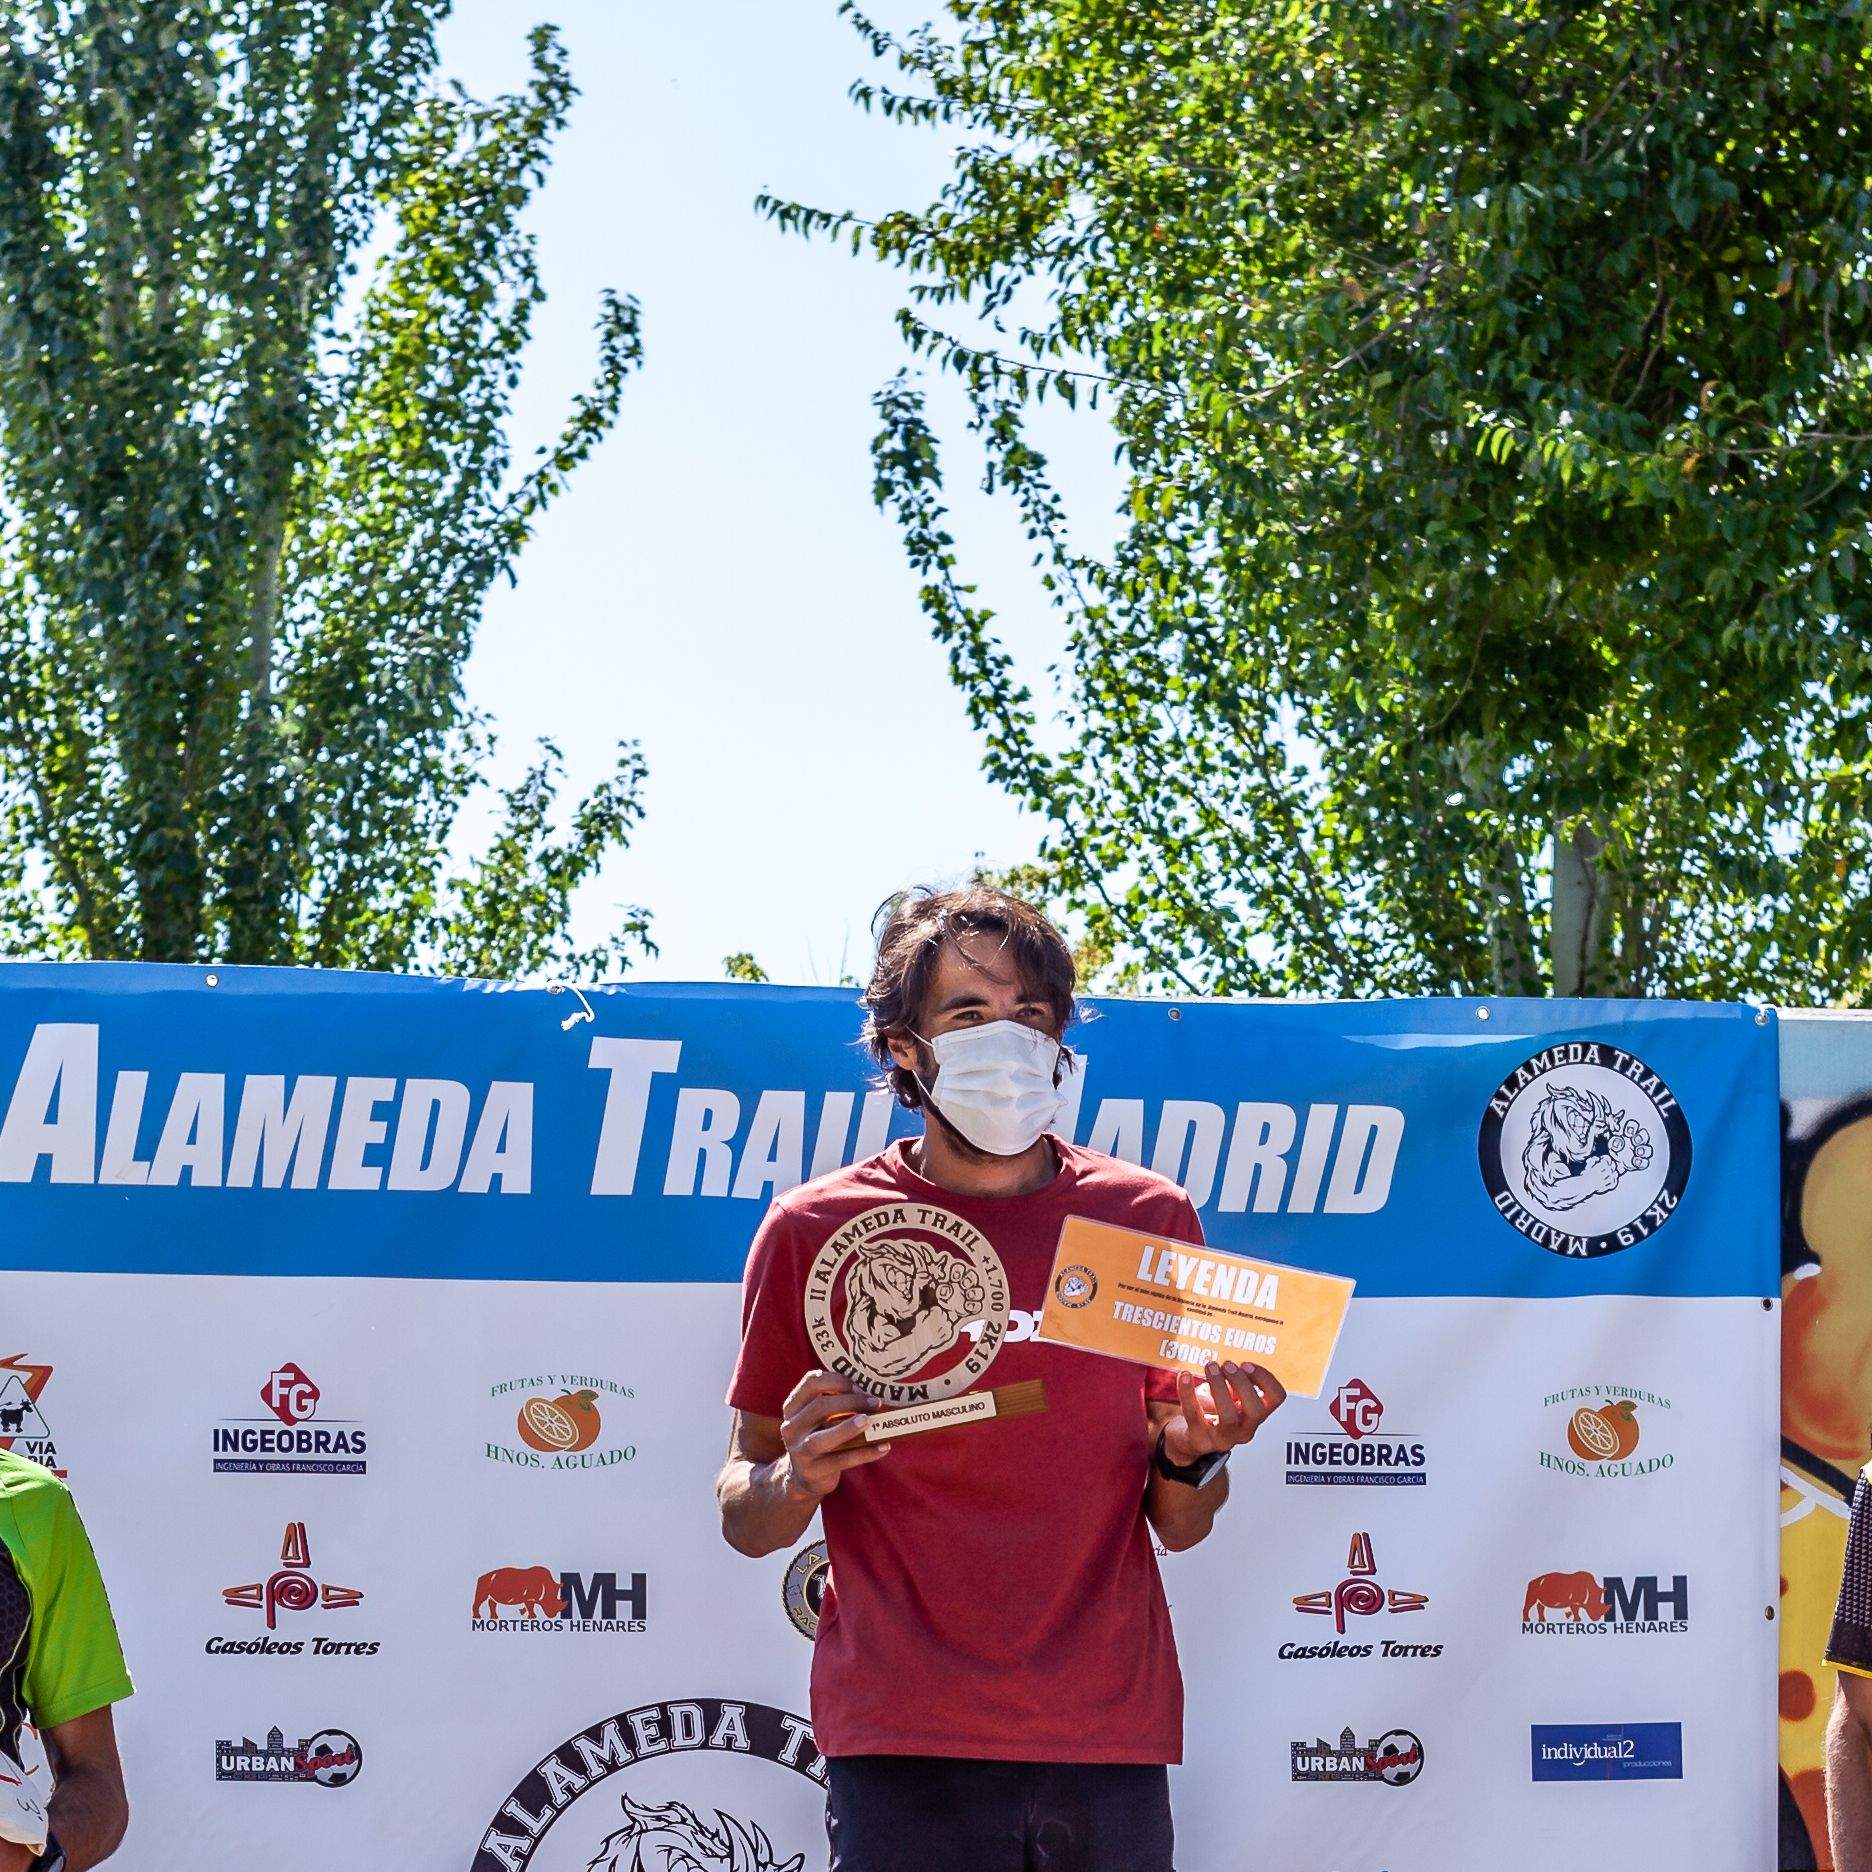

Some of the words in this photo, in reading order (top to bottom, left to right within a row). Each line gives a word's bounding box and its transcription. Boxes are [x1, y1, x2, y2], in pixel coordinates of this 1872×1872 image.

[1489, 1043, 1601, 1119] ALAMEDA
[1613, 1049, 1678, 1120] TRAIL
[1494, 1190, 1589, 1257] MADRID
[1617, 1189, 1679, 1247] 2K19
[814, 1207, 908, 1288] ALAMEDA
[917, 1208, 983, 1253] TRAIL
[1136, 1245, 1280, 1310] LEYENDA
[1112, 1301, 1223, 1344] TRESCIENTOS
[1224, 1327, 1278, 1355] EUROS
[490, 1376, 545, 1399] FRUTAS
[546, 1374, 558, 1387] Y
[560, 1374, 636, 1400] VERDURAS
[1542, 1387, 1592, 1409] FRUTAS
[1593, 1385, 1605, 1397] Y
[1605, 1384, 1672, 1410] VERDURAS
[882, 1411, 931, 1430] ABSOLUTO
[931, 1401, 985, 1425] MASCULINO
[212, 1427, 367, 1455] INGEOBRAS
[1285, 1442, 1427, 1467] INGEOBRAS
[291, 1462, 334, 1473] FRANCISCO
[484, 1441, 547, 1471] HNOS.
[550, 1445, 638, 1471] AGUADO
[1538, 1450, 1591, 1477] HNOS.
[1595, 1453, 1675, 1479] AGUADO
[1356, 1474, 1396, 1484] FRANCISCO
[559, 1572, 647, 1620] MH
[1603, 1574, 1689, 1622] MH
[471, 1618, 564, 1633] MORTEROS
[568, 1619, 647, 1633] HENARES
[1521, 1621, 1608, 1636] MORTEROS
[1612, 1621, 1689, 1634] HENARES
[204, 1636, 305, 1656] Gasóleos
[312, 1636, 381, 1657] Torres
[1278, 1640, 1373, 1661] Gasóleos
[1380, 1640, 1444, 1659] Torres
[221, 1755, 296, 1773] URBAN
[1541, 1739, 1635, 1762] individual2
[1296, 1756, 1366, 1773] URBAN
